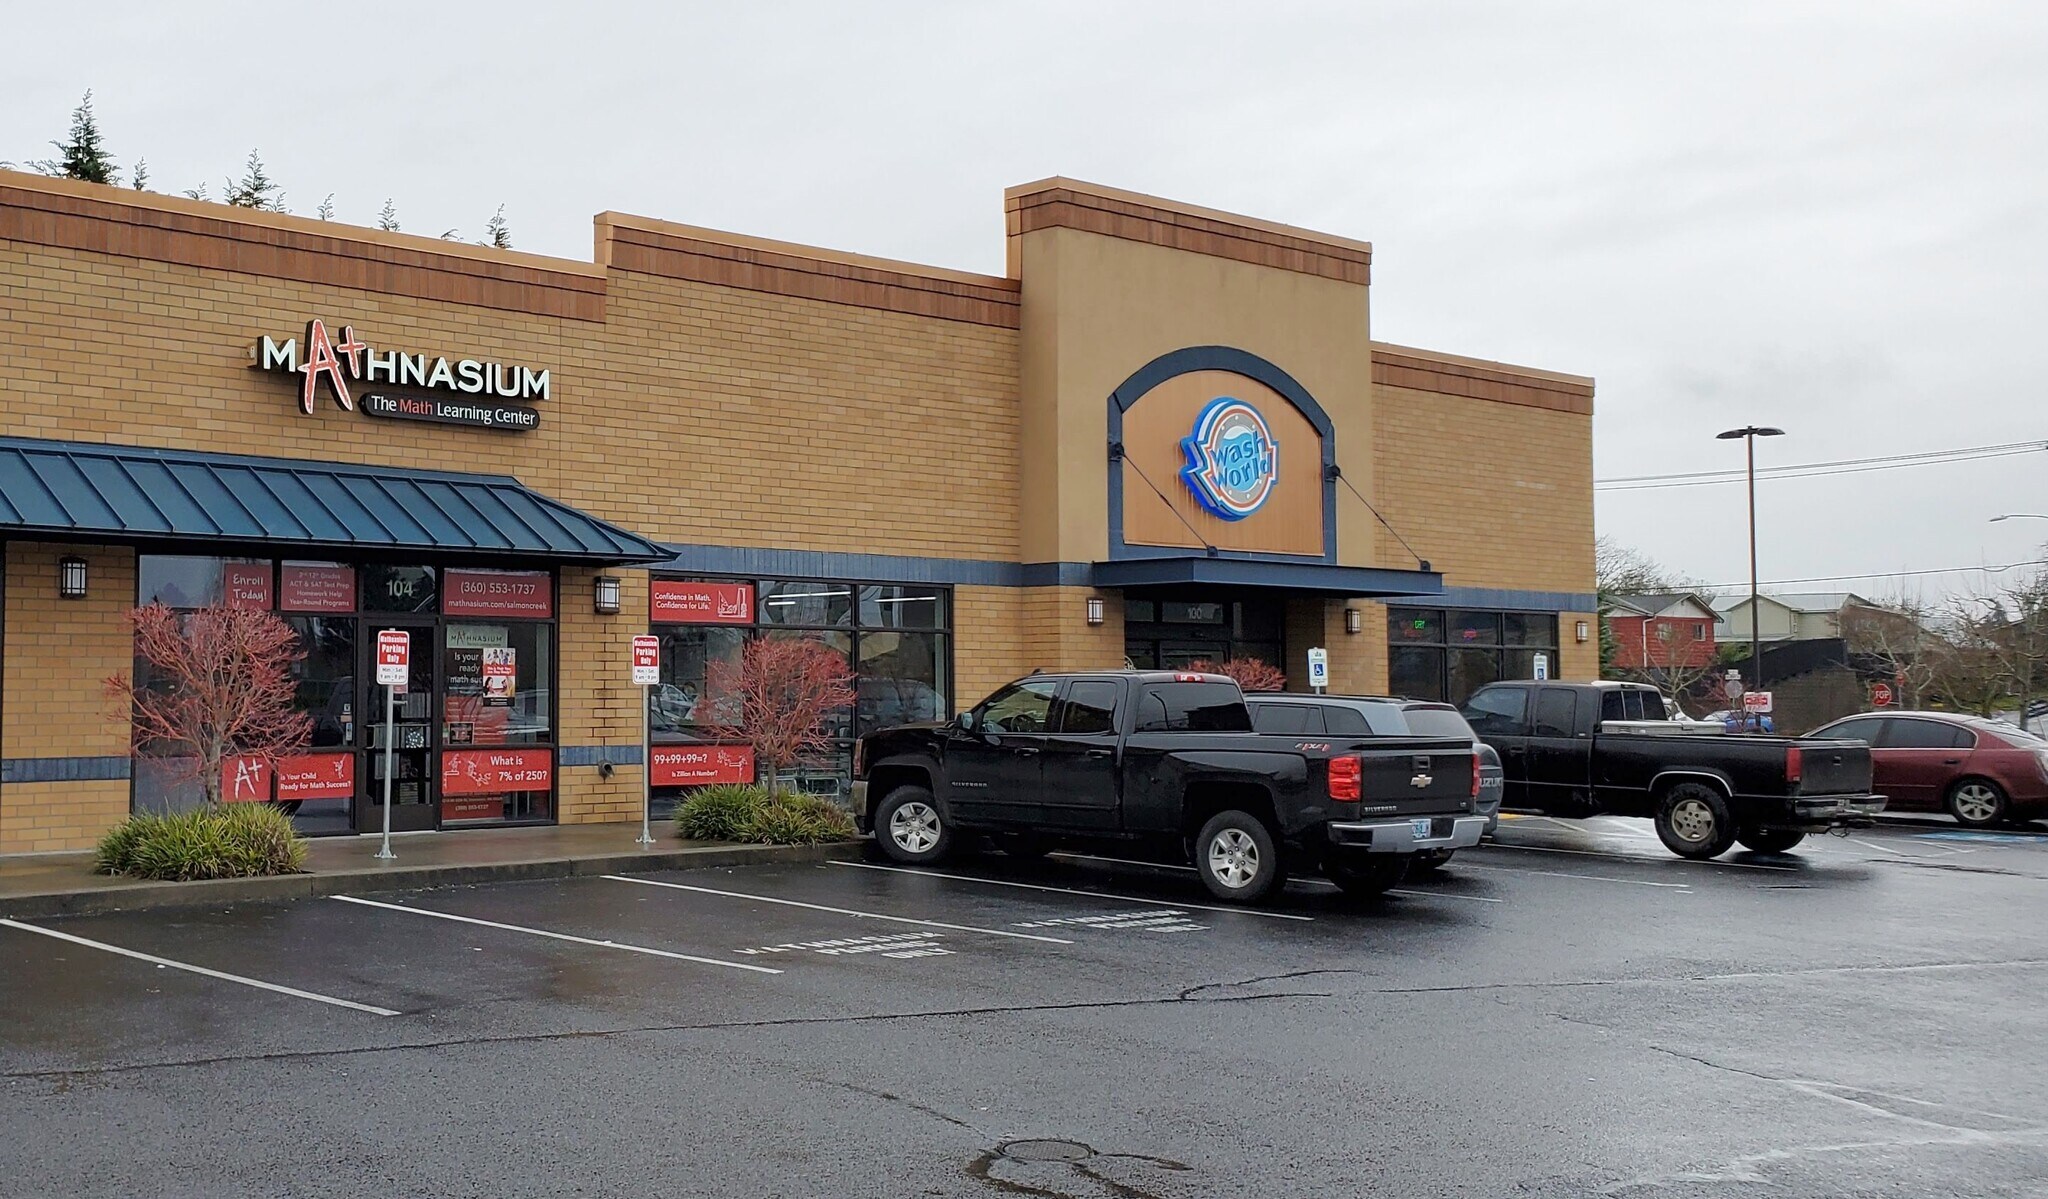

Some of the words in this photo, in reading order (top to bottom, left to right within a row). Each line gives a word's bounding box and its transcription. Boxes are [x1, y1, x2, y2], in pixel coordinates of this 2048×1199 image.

[371, 396, 397, 412] The
[399, 398, 433, 416] Math
[437, 402, 492, 424] Learning
[494, 408, 536, 426] Center
[233, 573, 263, 586] Enroll
[289, 580, 302, 588] ACT
[386, 579, 413, 597] 104
[460, 582, 486, 595] (360)
[489, 582, 536, 596] 553-1737
[233, 588, 267, 602] Today!
[296, 590, 328, 598] Homework
[654, 592, 687, 601] Confidence
[688, 593, 694, 601] in
[322, 598, 350, 608] Programs
[448, 599, 547, 611] mathnasium.com/salmoncreek
[656, 600, 688, 609] Confidence
[688, 601, 697, 609] for
[381, 643, 406, 655] Parking
[635, 647, 656, 657] Parking
[386, 654, 400, 664] Only
[454, 651, 461, 661] Is
[462, 653, 479, 663] your
[640, 656, 652, 666] Only
[458, 663, 481, 674] ready
[450, 675, 469, 684] math
[490, 755, 514, 766] What
[515, 755, 523, 765] is
[654, 753, 708, 765] 99+99+99=?
[301, 772, 317, 780] Child
[498, 771, 513, 782] 7%
[514, 771, 525, 781] of
[526, 770, 548, 780] 250?
[696, 769, 718, 777] Number?
[280, 782, 298, 791] Ready
[310, 781, 325, 789] Math
[326, 780, 352, 788] Success?
[1479, 777, 1503, 788] UZUK
